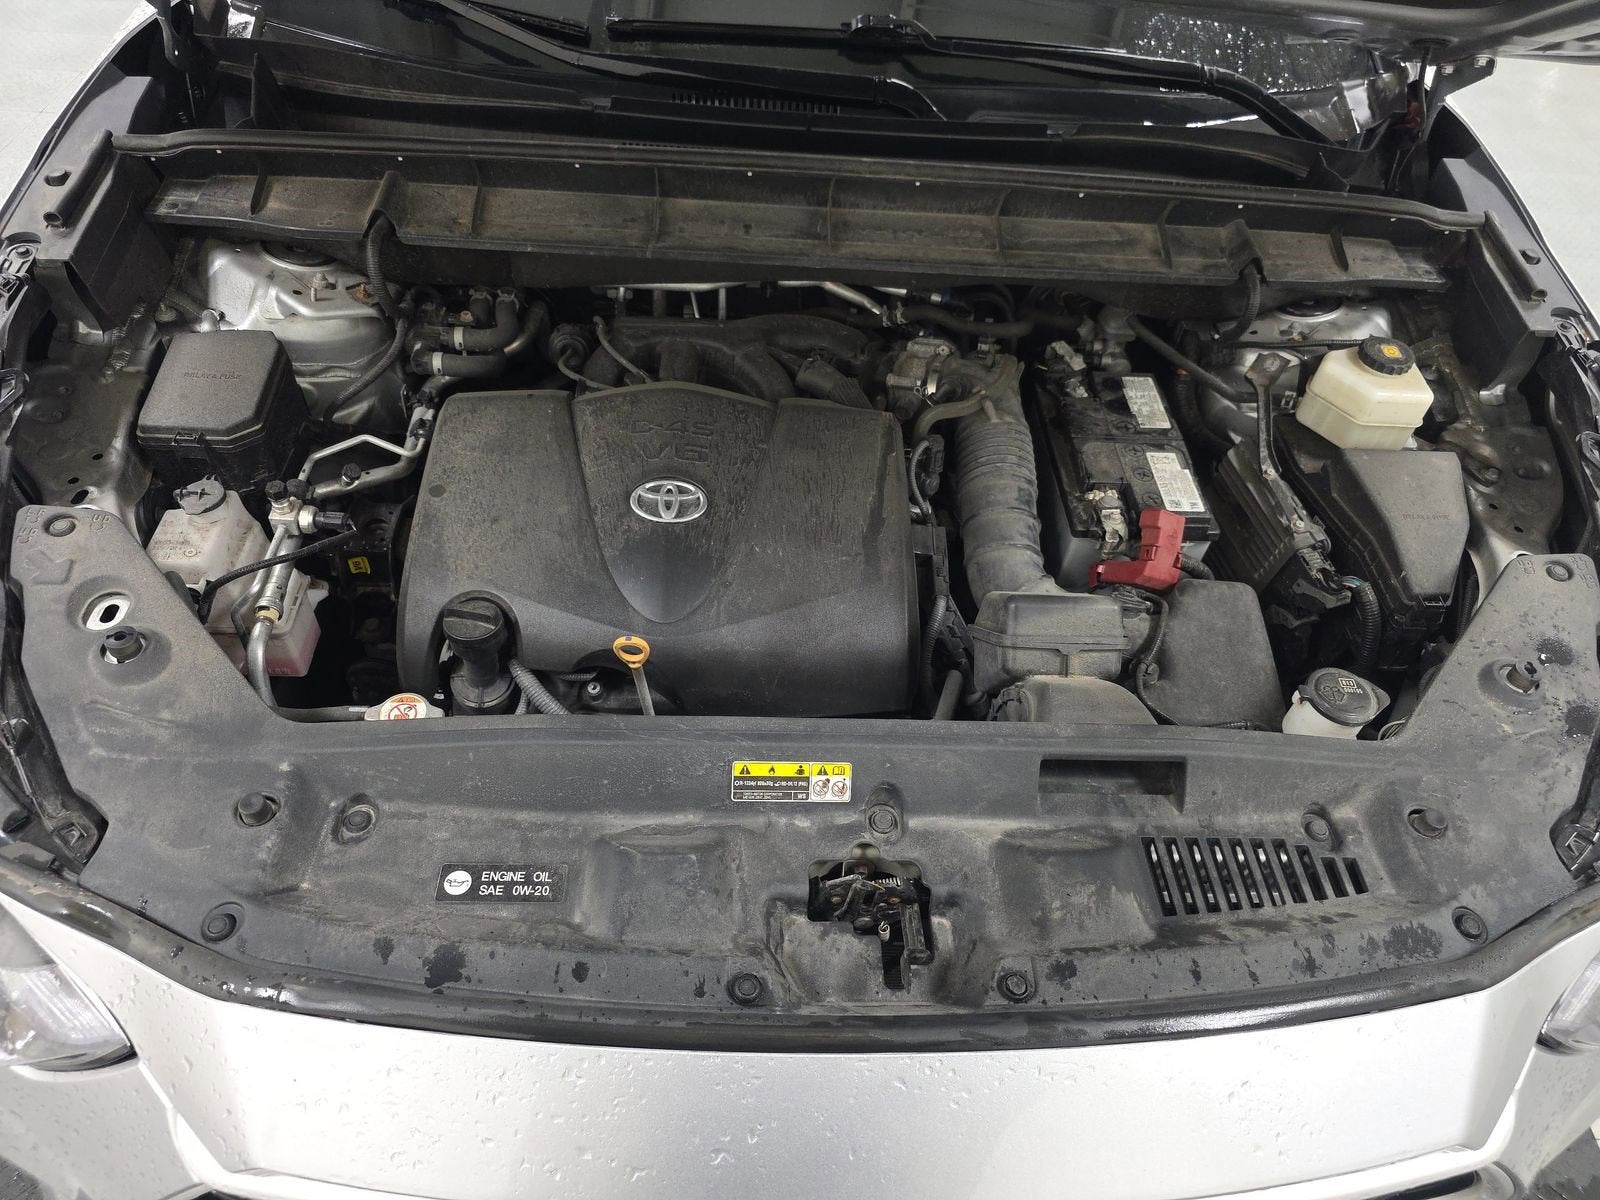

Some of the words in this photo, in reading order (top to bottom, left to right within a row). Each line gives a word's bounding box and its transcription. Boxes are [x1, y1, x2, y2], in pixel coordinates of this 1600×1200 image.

[631, 420, 714, 438] D-4S
[639, 442, 710, 464] V6
[481, 871, 525, 882] ENGINE
[533, 871, 552, 882] OIL
[479, 885, 504, 896] SAE
[513, 885, 550, 896] 0W-20
